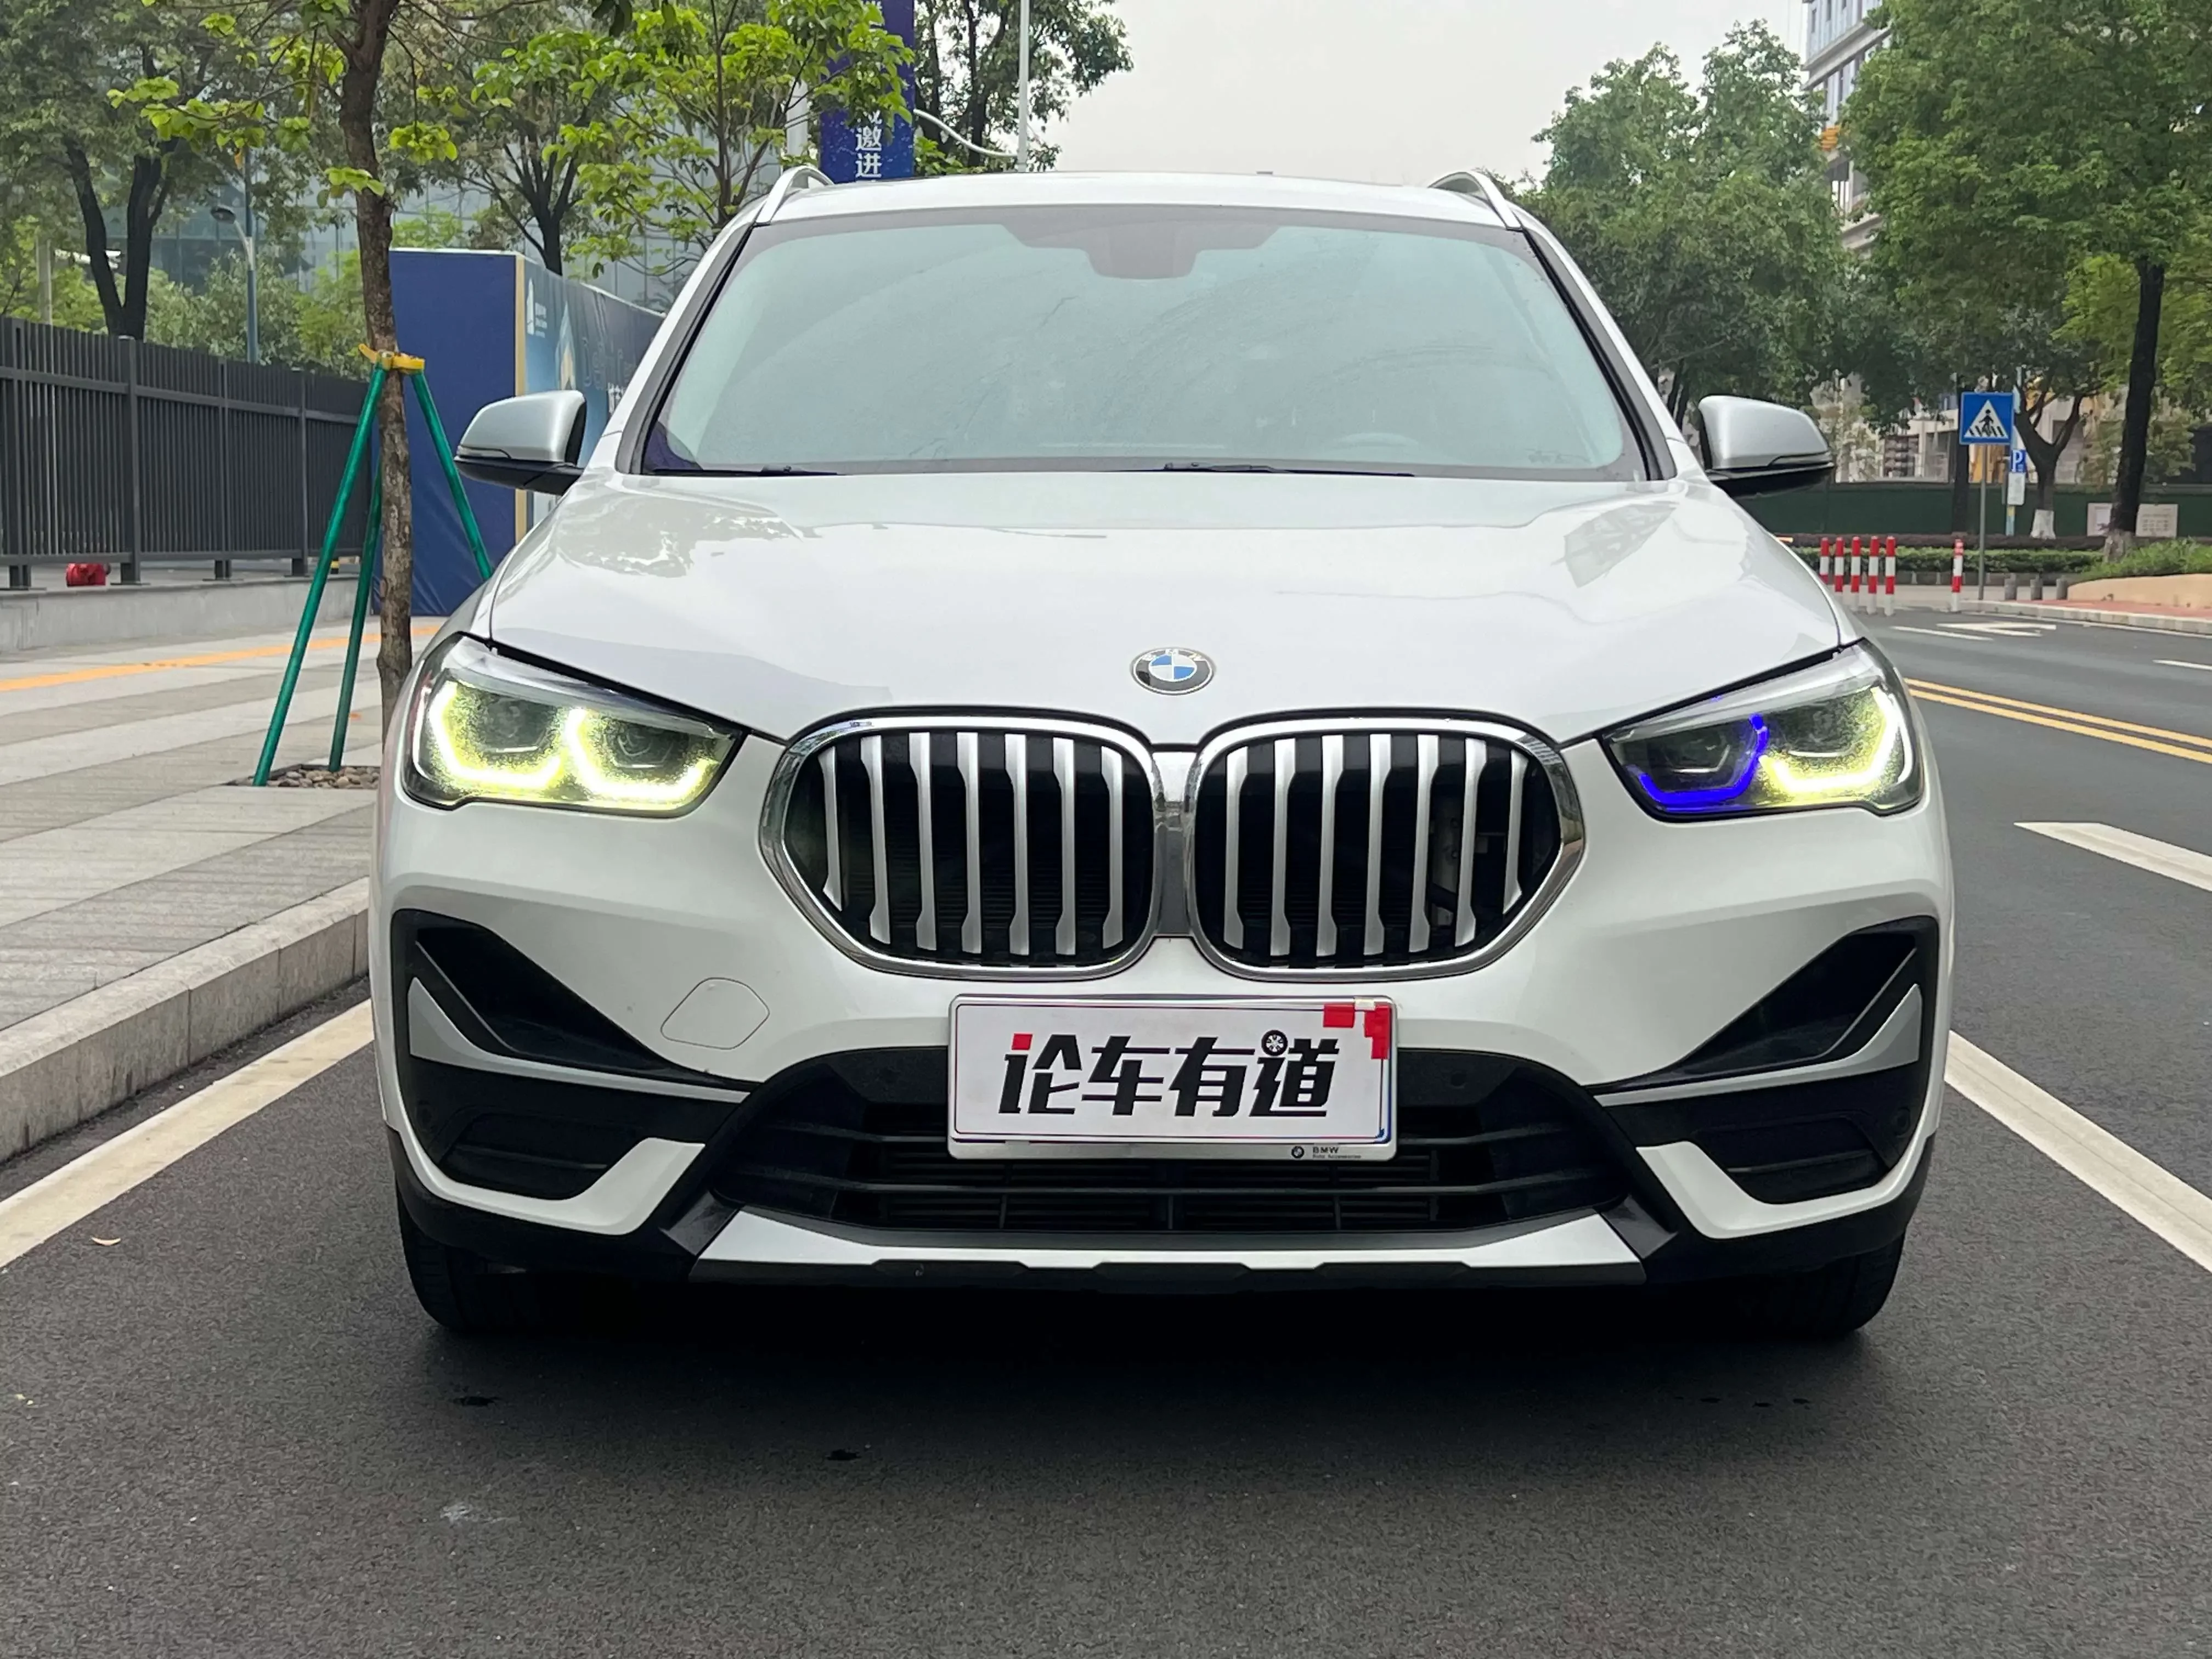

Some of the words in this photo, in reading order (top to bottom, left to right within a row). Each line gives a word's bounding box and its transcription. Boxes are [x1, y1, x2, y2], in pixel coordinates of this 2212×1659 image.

[2012, 449, 2023, 472] P
[998, 1029, 1340, 1118] 论车有道
